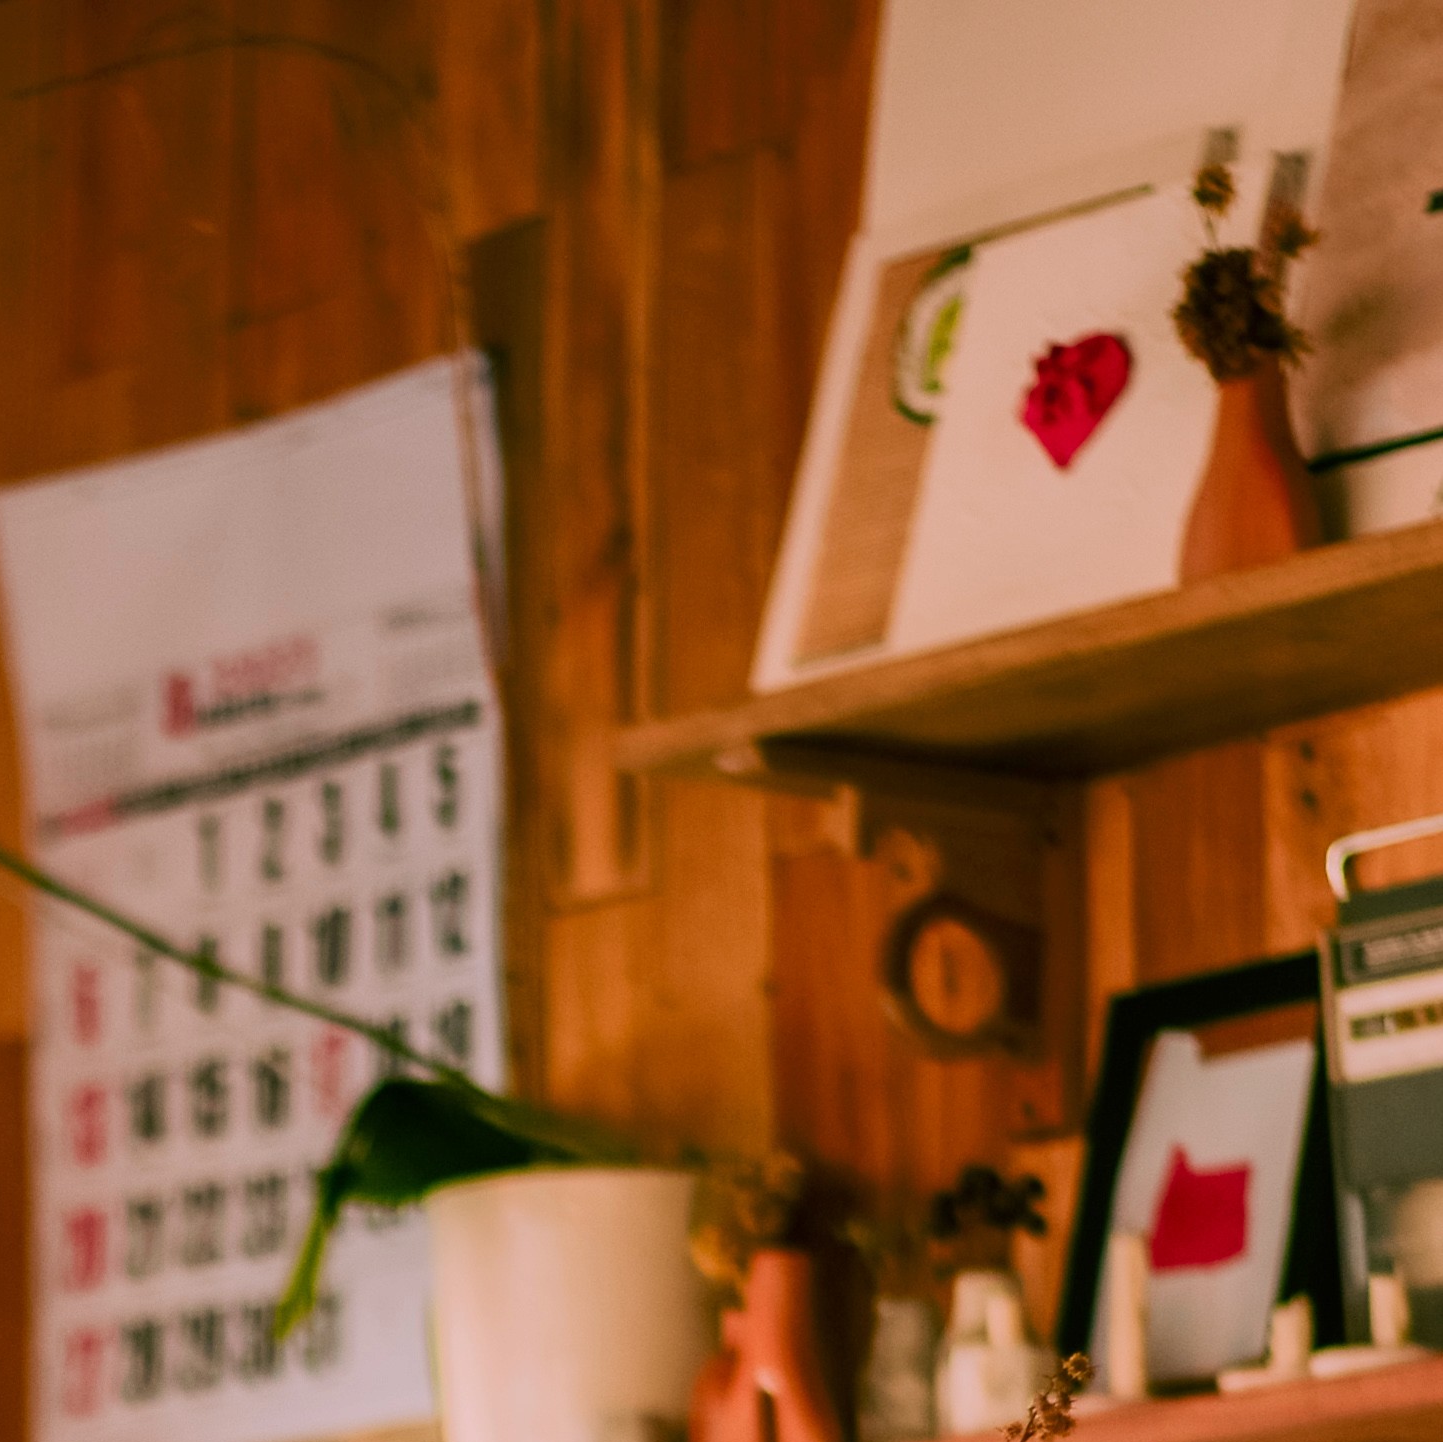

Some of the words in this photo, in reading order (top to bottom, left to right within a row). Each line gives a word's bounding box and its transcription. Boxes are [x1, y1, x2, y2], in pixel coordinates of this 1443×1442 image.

[259, 799, 288, 884] 2
[430, 743, 460, 829] 5
[429, 869, 470, 958] 12
